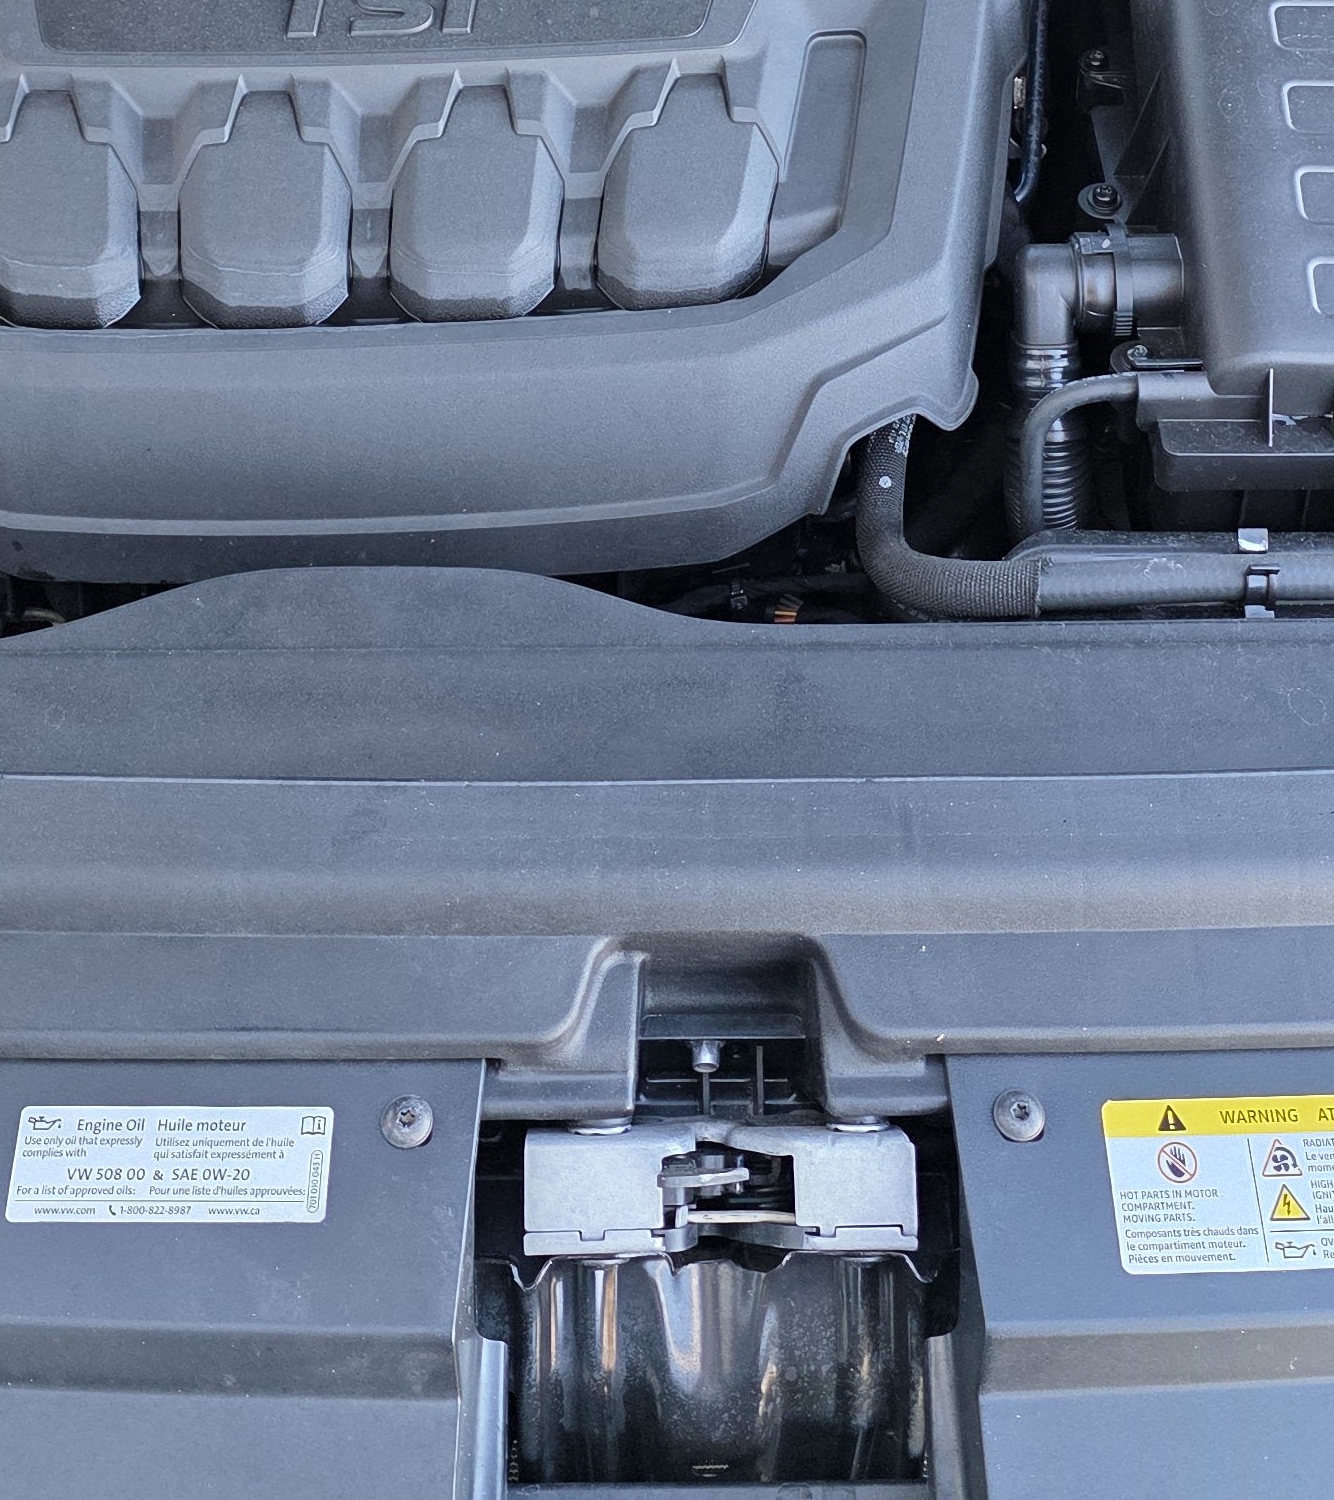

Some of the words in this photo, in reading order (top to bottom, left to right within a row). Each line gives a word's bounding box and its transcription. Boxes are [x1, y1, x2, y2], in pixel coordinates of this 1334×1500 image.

[1219, 1108, 1299, 1125] WARNING
[77, 1118, 123, 1135] Engine
[126, 1117, 146, 1132] Oil
[157, 1118, 193, 1132] Huile
[196, 1119, 247, 1132] moteur
[24, 1135, 42, 1146] Use
[43, 1135, 64, 1148] only
[64, 1135, 77, 1146] oil
[78, 1135, 98, 1146] that
[99, 1135, 143, 1149] expressly
[155, 1137, 190, 1147] Utilisez
[192, 1137, 251, 1150] uniquement
[251, 1137, 265, 1147] de
[265, 1136, 295, 1148] l'huile
[22, 1147, 64, 1160] complies
[65, 1147, 87, 1158] with
[153, 1149, 169, 1162] qui
[170, 1148, 209, 1159] satisfait
[210, 1149, 277, 1162] expressément
[278, 1149, 285, 1159] à
[1305, 1151, 1317, 1161] Le
[67, 1168, 93, 1181] VW
[95, 1167, 123, 1181] 508
[126, 1167, 146, 1181] 00
[152, 1169, 164, 1181] &
[171, 1168, 199, 1181] SAE
[202, 1168, 251, 1181] 0W-20
[1310, 1179, 1334, 1189] HIGH
[16, 1185, 33, 1195] For
[33, 1187, 40, 1195] a
[41, 1185, 56, 1196] list
[57, 1184, 69, 1196] of
[69, 1185, 115, 1198] approved
[115, 1185, 136, 1195] oils:
[149, 1185, 171, 1196] Pour
[172, 1187, 191, 1196] une
[191, 1185, 212, 1196] liste
[212, 1185, 248, 1196] d'huiles
[249, 1185, 306, 1198] approuvées:
[1119, 1191, 1139, 1200] HOT
[1141, 1189, 1171, 1200] PARTS
[1171, 1189, 1183, 1199] IN
[1184, 1188, 1219, 1199] MOTOR
[34, 1207, 96, 1215] www.vw.com
[120, 1205, 192, 1216] 1-800-822-8987
[208, 1207, 261, 1216] www.vw.ca
[1121, 1200, 1196, 1212] COMPARTMENT.
[1123, 1213, 1162, 1224] MOVING
[1163, 1212, 1196, 1222] PARTS.
